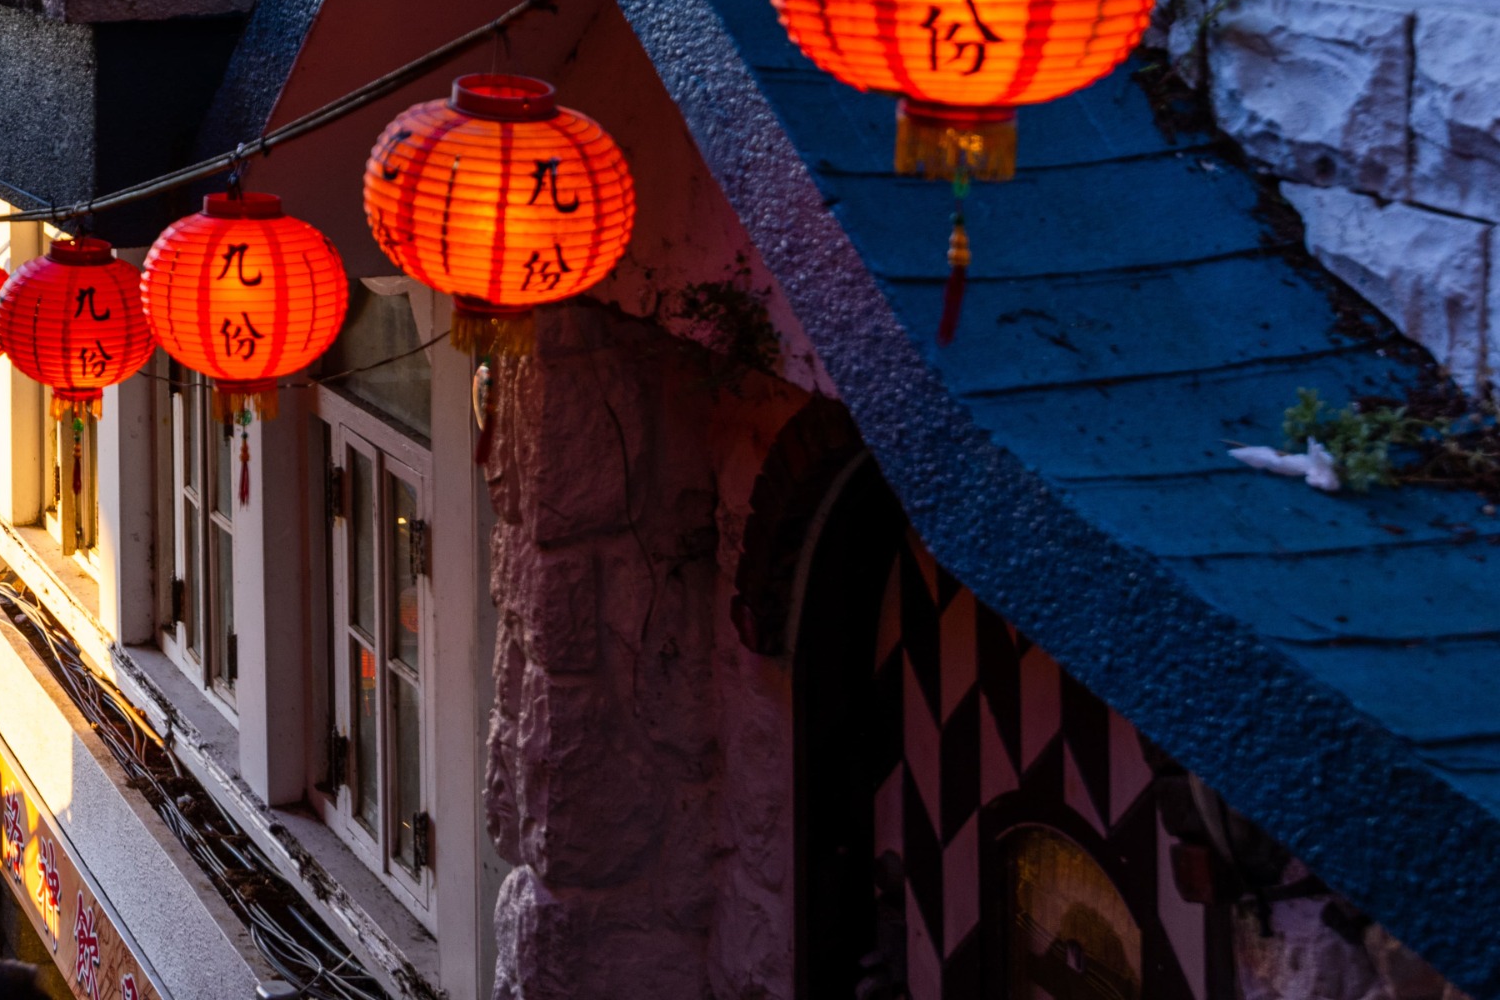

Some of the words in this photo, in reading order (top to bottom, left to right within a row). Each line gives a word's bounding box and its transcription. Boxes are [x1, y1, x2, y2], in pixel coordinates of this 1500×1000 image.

[520, 156, 579, 293] 九份
[74, 286, 112, 378] 九份
[217, 242, 265, 361] 九份
